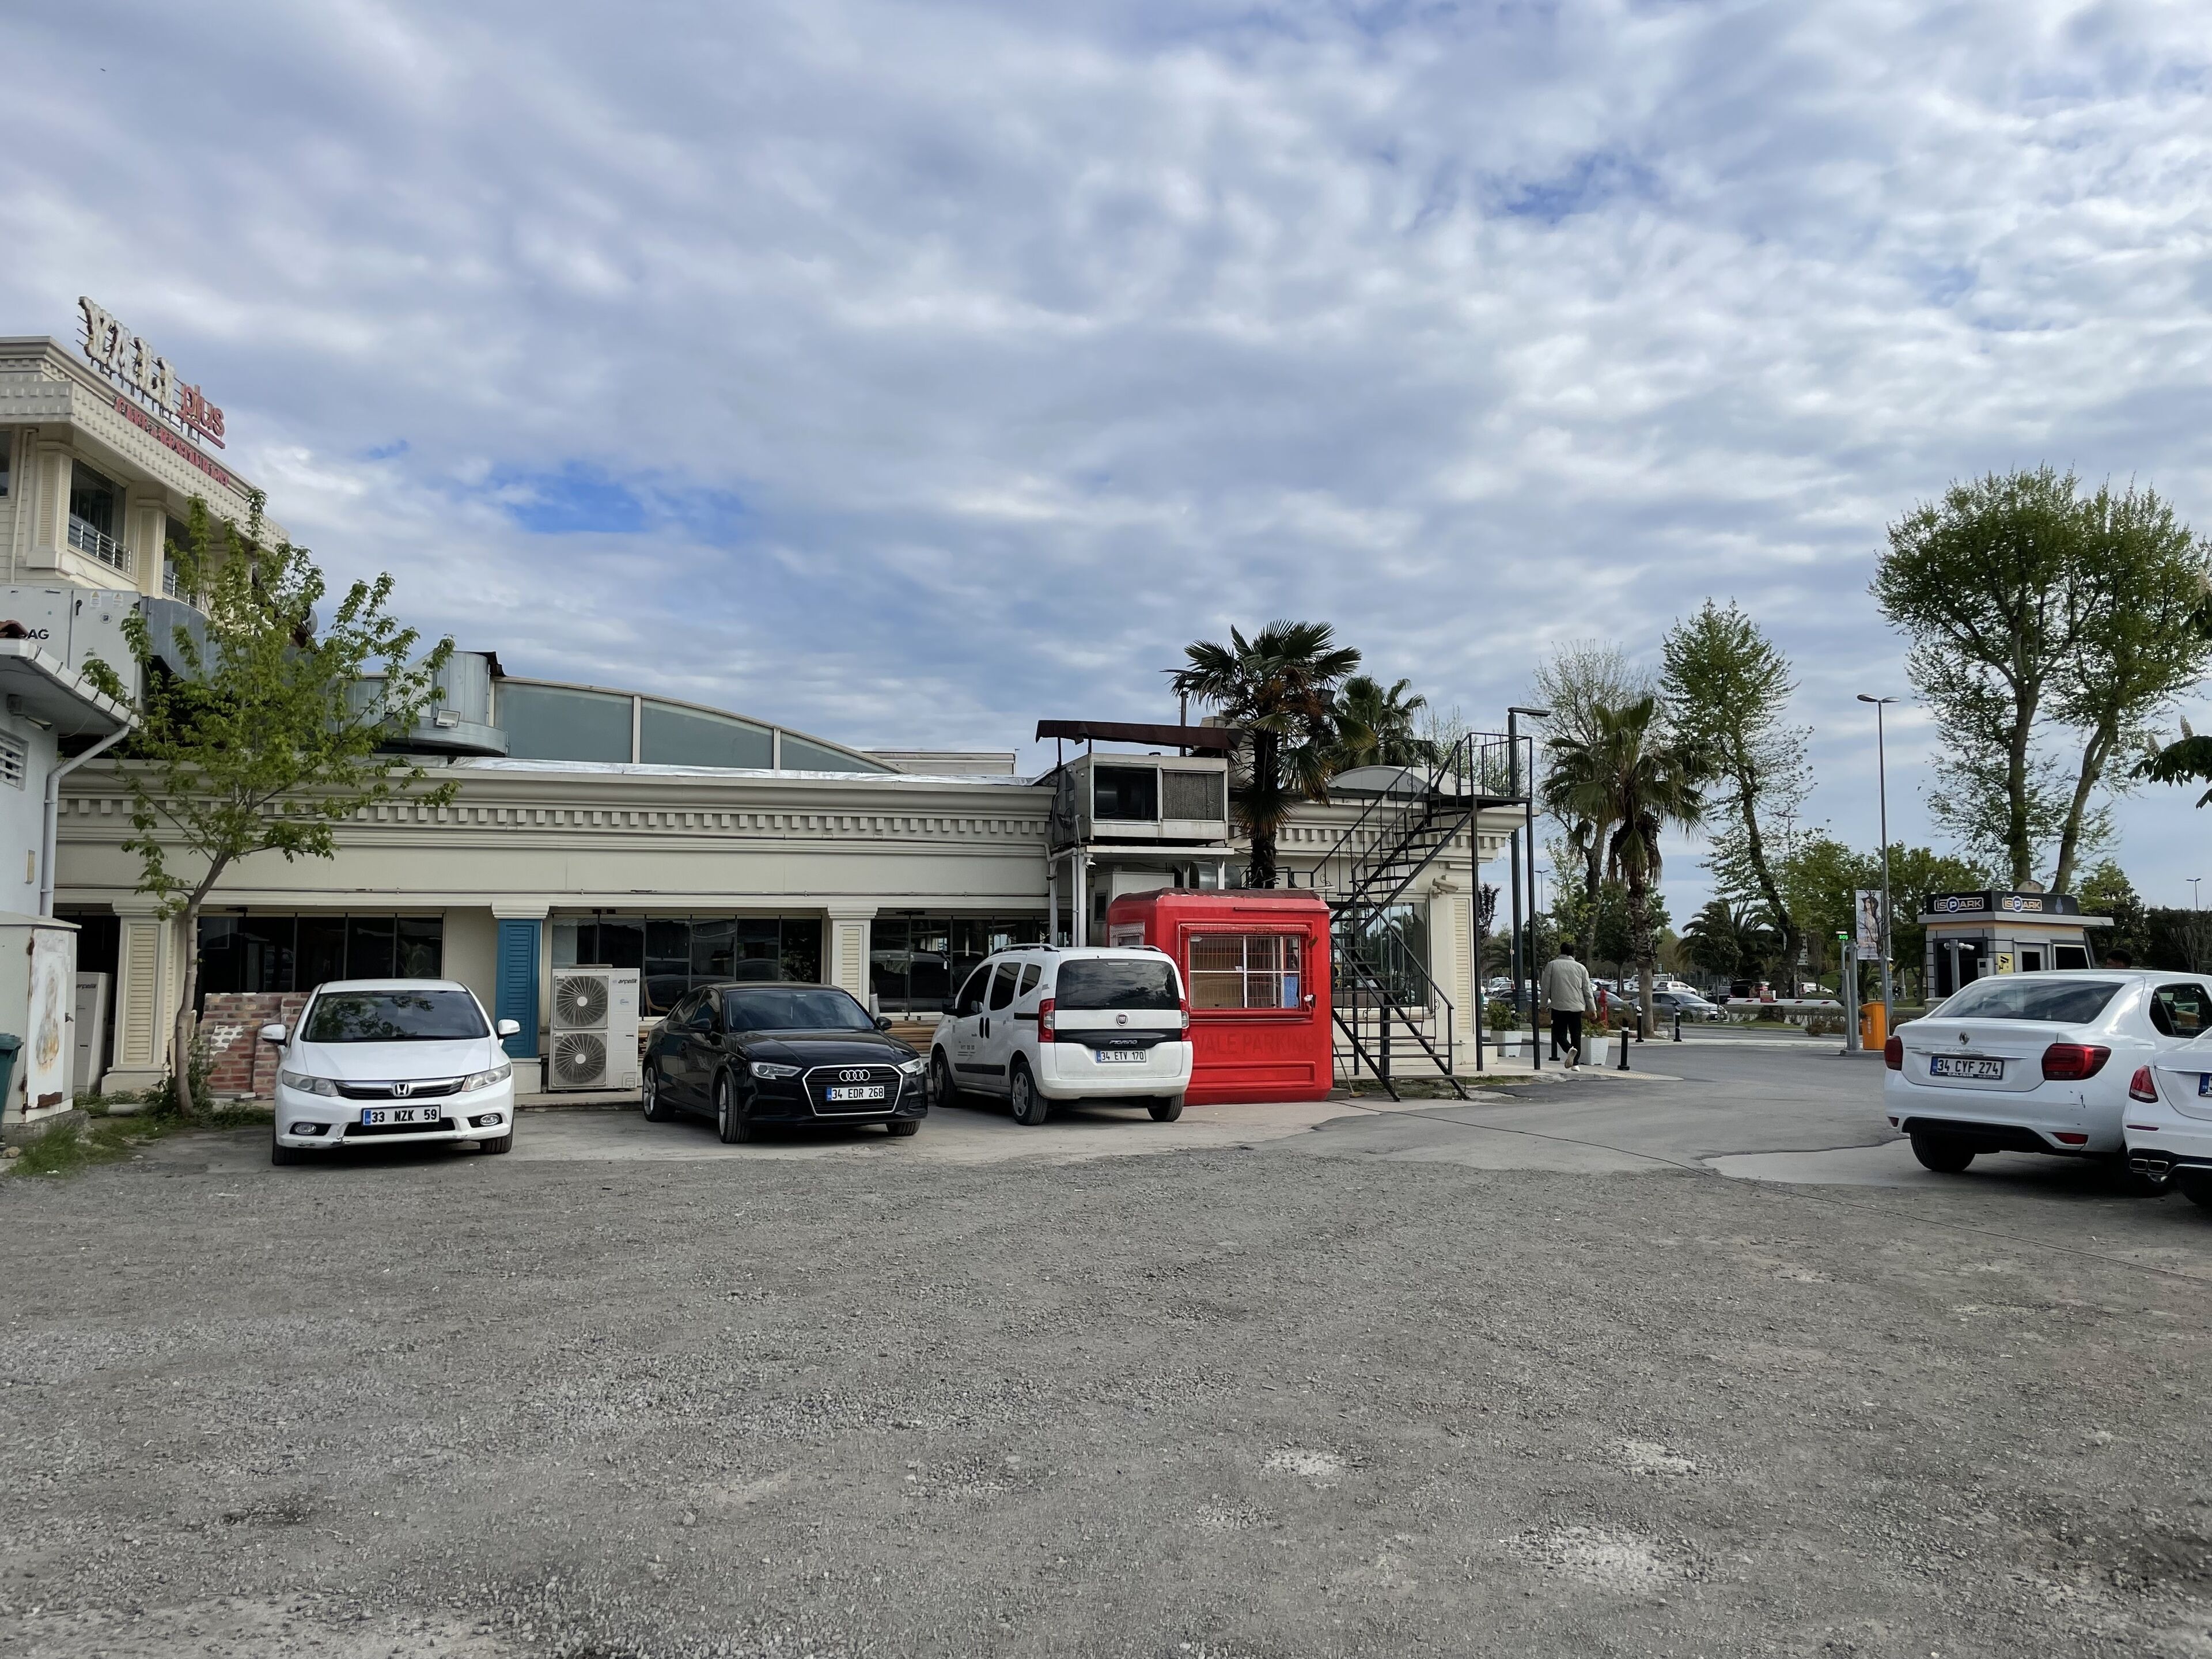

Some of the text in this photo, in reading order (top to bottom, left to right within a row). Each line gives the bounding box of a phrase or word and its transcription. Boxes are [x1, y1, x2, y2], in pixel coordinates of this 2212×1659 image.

[177, 383, 226, 437] plus
[1194, 1032, 1314, 1054] VALE PARKING
[1101, 1051, 1144, 1060] 34 ETY 170
[1937, 1059, 1999, 1074] 34 CYF 274
[832, 1087, 883, 1099] 34 EDR 268
[372, 1111, 385, 1123] 33
[394, 1109, 415, 1122] NZK
[423, 1108, 437, 1120] 59
